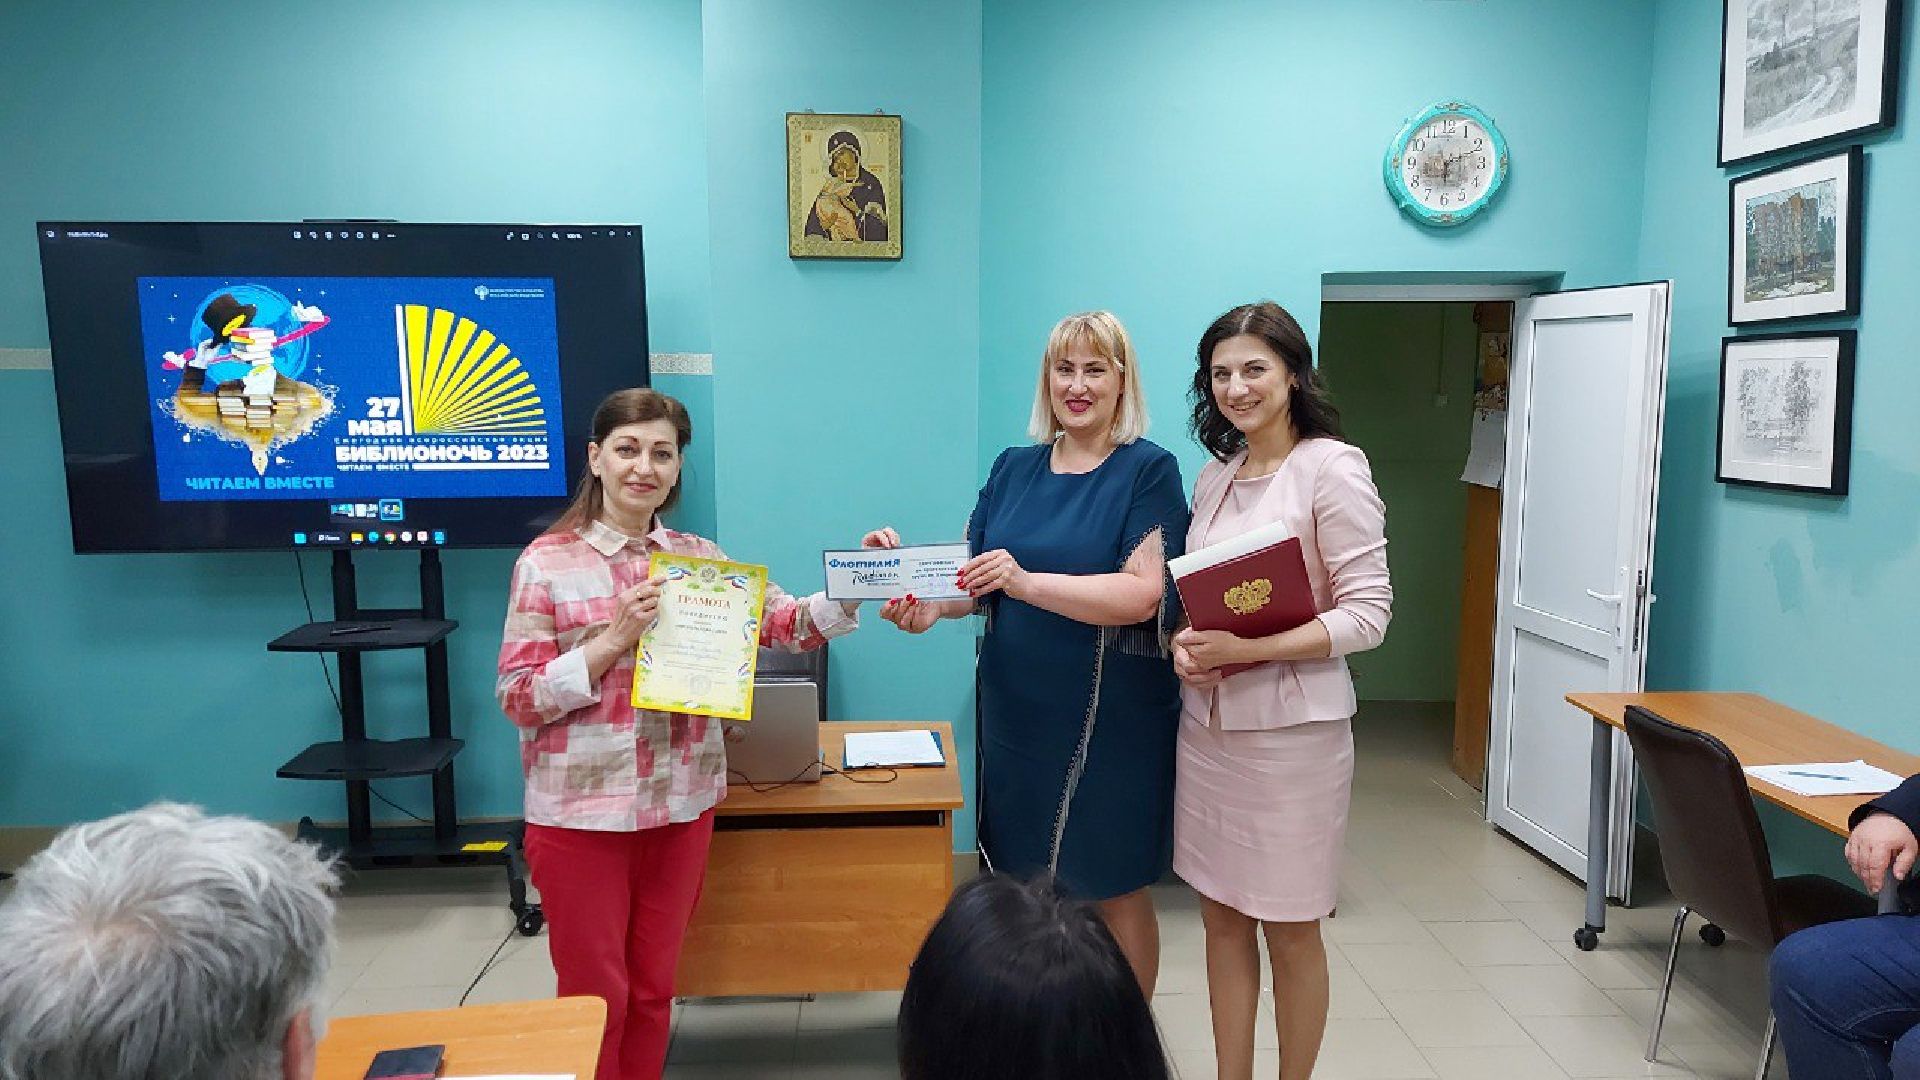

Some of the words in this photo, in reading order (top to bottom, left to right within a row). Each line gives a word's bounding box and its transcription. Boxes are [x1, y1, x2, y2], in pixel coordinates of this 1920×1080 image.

[1426, 125, 1437, 138] 11
[1443, 120, 1456, 133] 12
[1412, 138, 1425, 151] 10
[1473, 138, 1482, 151] 2
[1408, 156, 1416, 169] 9
[1477, 156, 1486, 169] 3
[1411, 175, 1419, 189] 8
[1471, 175, 1479, 187] 4
[1425, 188, 1432, 201] 7
[1440, 193, 1449, 206] 6
[1458, 188, 1466, 201] 5
[366, 396, 401, 418] 27
[335, 445, 493, 463] БИБЛИОНОЧЬ
[496, 444, 550, 461] 2023
[336, 463, 373, 472] ЧИТАЕМ
[185, 476, 260, 490] ЧИТАЕМ
[264, 476, 335, 490] ВМЕСТЕ
[678, 594, 731, 609] ГРАМОТА
